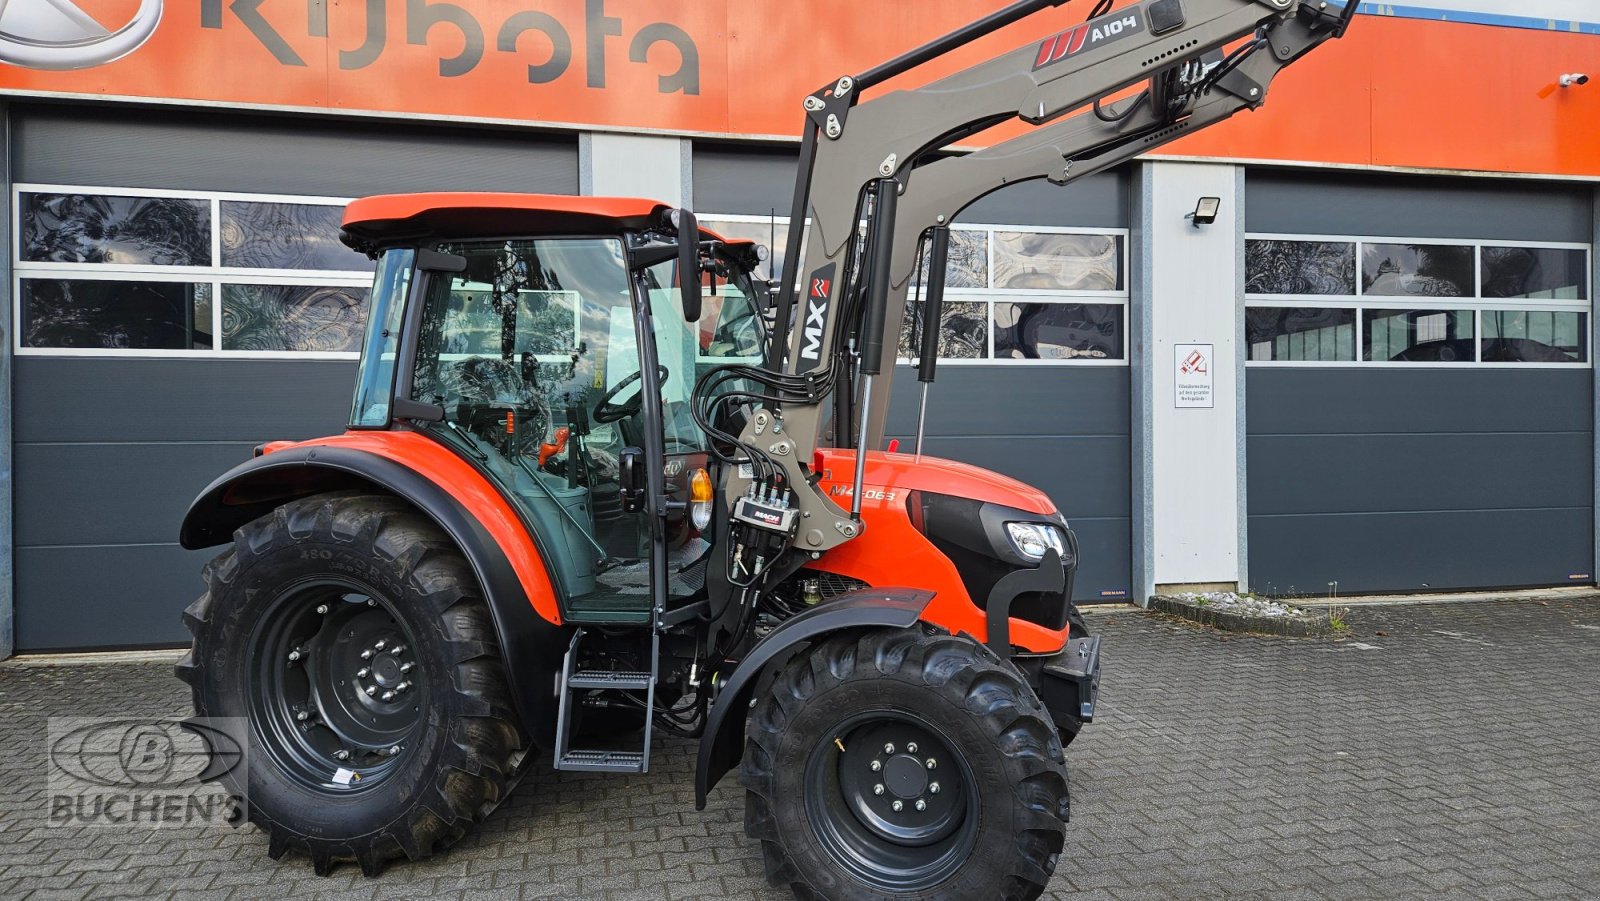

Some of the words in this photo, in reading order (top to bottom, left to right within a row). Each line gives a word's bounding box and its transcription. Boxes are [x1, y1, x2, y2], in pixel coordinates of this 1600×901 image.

[1091, 15, 1137, 43] A104
[801, 299, 827, 360] MX
[754, 511, 781, 522] MACH
